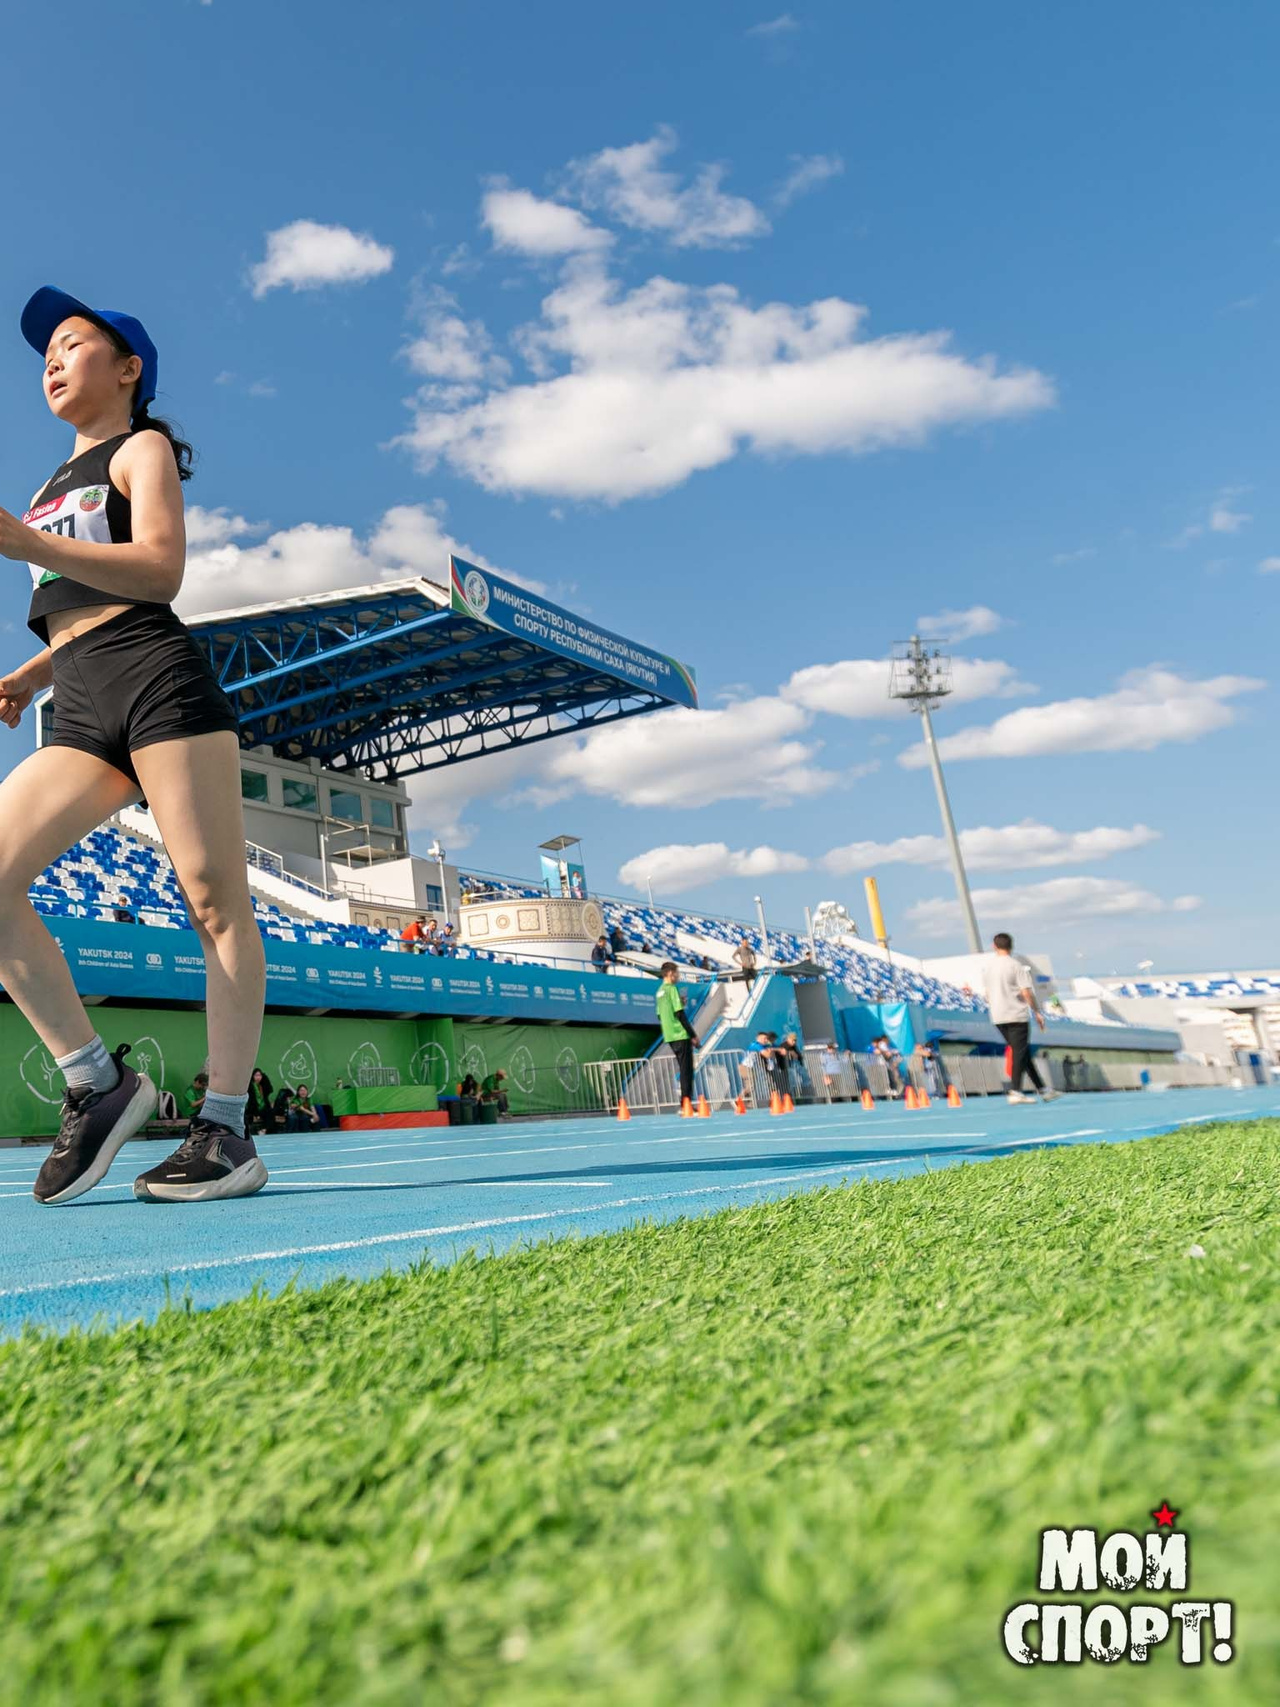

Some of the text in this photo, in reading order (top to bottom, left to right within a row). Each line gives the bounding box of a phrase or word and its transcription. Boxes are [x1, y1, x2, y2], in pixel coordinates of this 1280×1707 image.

[493, 586, 671, 676] МИНИСТЕРСТВО ПО ФИЗИЧЕСКОЙ КУЛЬТУРЕ И
[514, 613, 658, 687] СПОРТУ РЕСПУБЛИКИ САХА (ЯКУТИЯ)
[78, 948, 133, 960] YAKUTSK 2024
